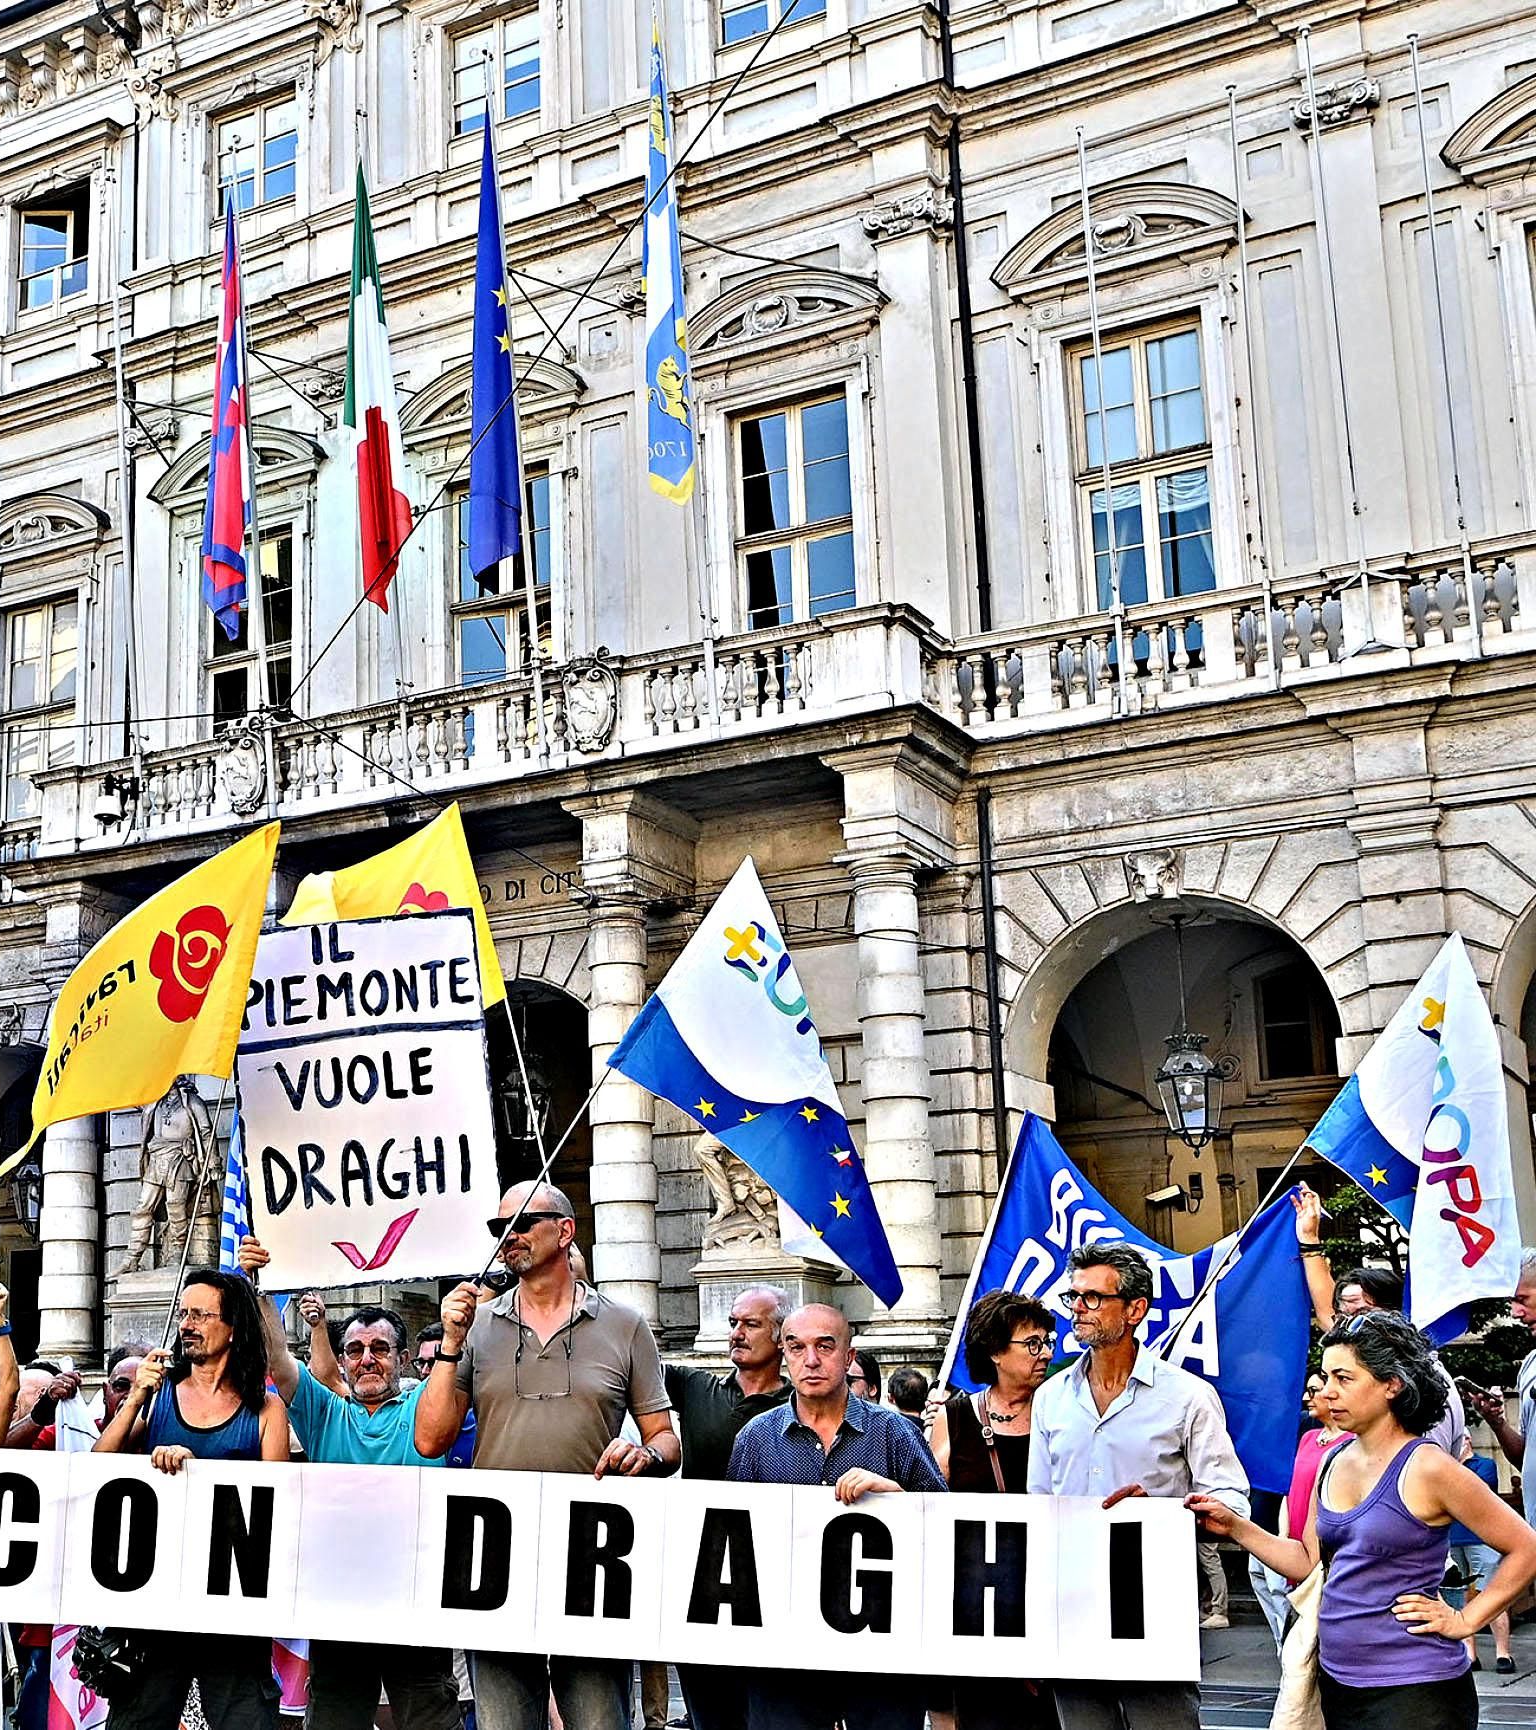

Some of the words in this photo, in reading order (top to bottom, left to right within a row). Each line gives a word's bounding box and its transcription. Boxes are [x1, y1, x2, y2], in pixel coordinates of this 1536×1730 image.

[505, 879, 526, 901] DI
[540, 870, 582, 895] CIT
[311, 924, 354, 965] IL
[241, 957, 476, 1032] PIEMONTE
[274, 1046, 433, 1112] VUOLE
[263, 1134, 471, 1216] DRAGHI
[440, 1495, 1145, 1640] DRAGHI
